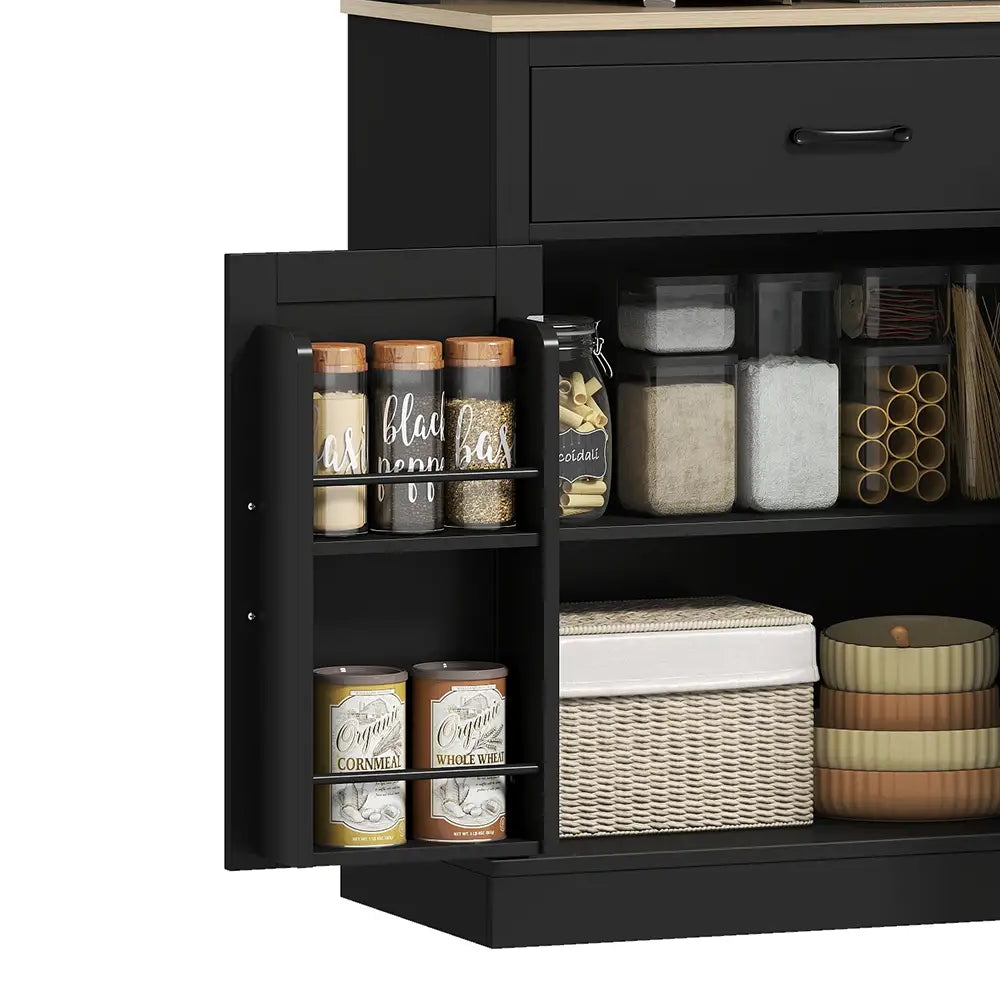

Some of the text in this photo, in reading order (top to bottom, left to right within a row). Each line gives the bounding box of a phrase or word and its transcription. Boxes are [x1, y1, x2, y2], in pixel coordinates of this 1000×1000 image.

[336, 705, 399, 754] Organic
[437, 700, 500, 750] Organic
[337, 755, 401, 771] CORNMEAL
[436, 751, 504, 765] WHOLE WHEAT
